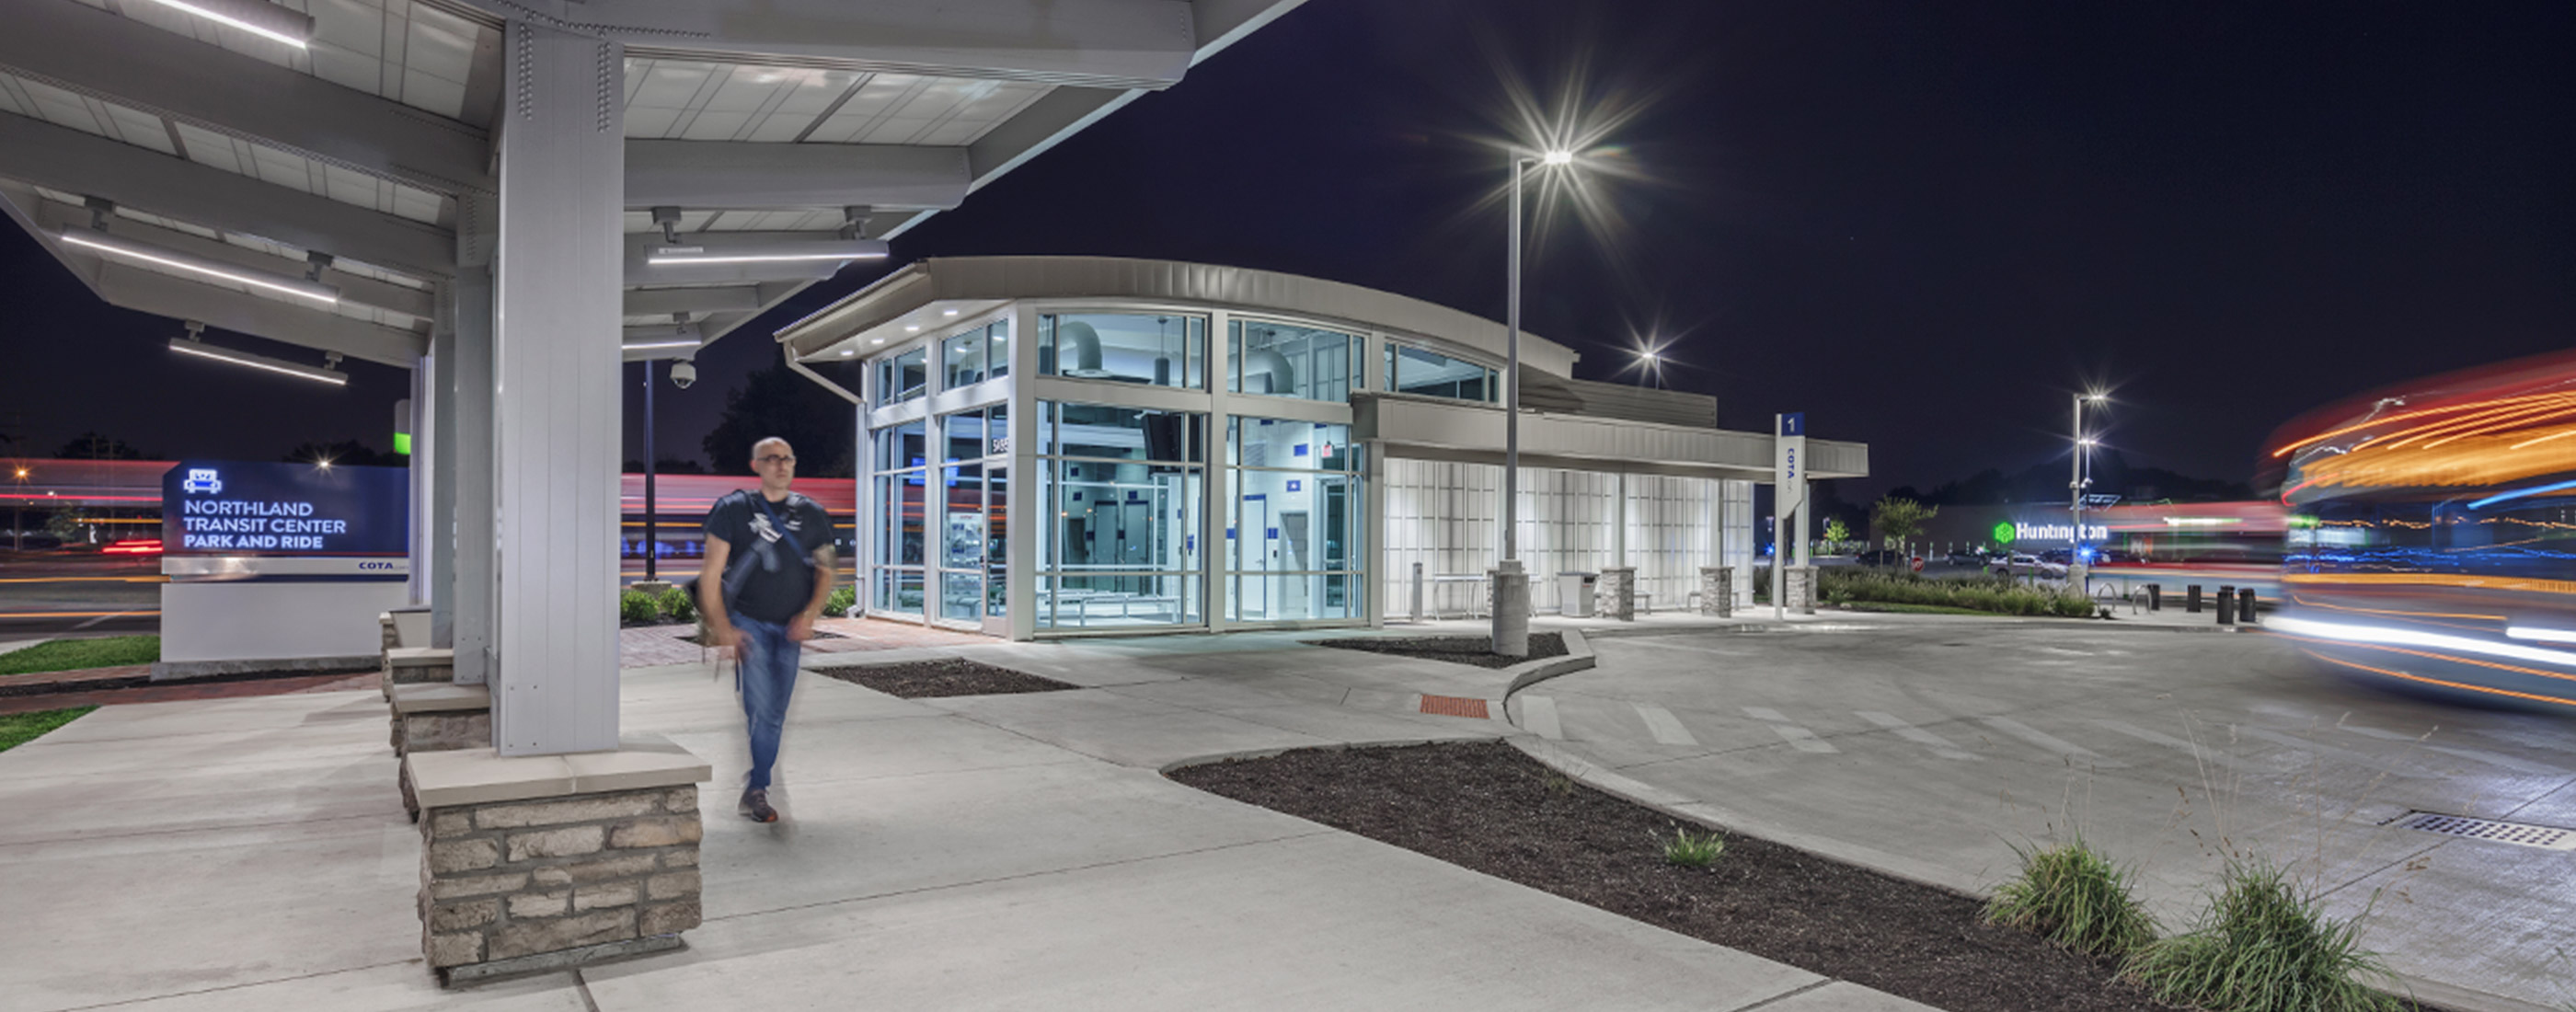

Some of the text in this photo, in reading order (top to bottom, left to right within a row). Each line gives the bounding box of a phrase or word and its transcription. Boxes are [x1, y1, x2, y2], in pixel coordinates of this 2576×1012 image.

[1788, 417, 1795, 432] 1
[184, 500, 314, 517] NORTHLAND
[184, 517, 346, 534] TRANSIT CENTER
[2016, 522, 2109, 544] Huntington
[184, 534, 324, 549] PARK AND RIDE
